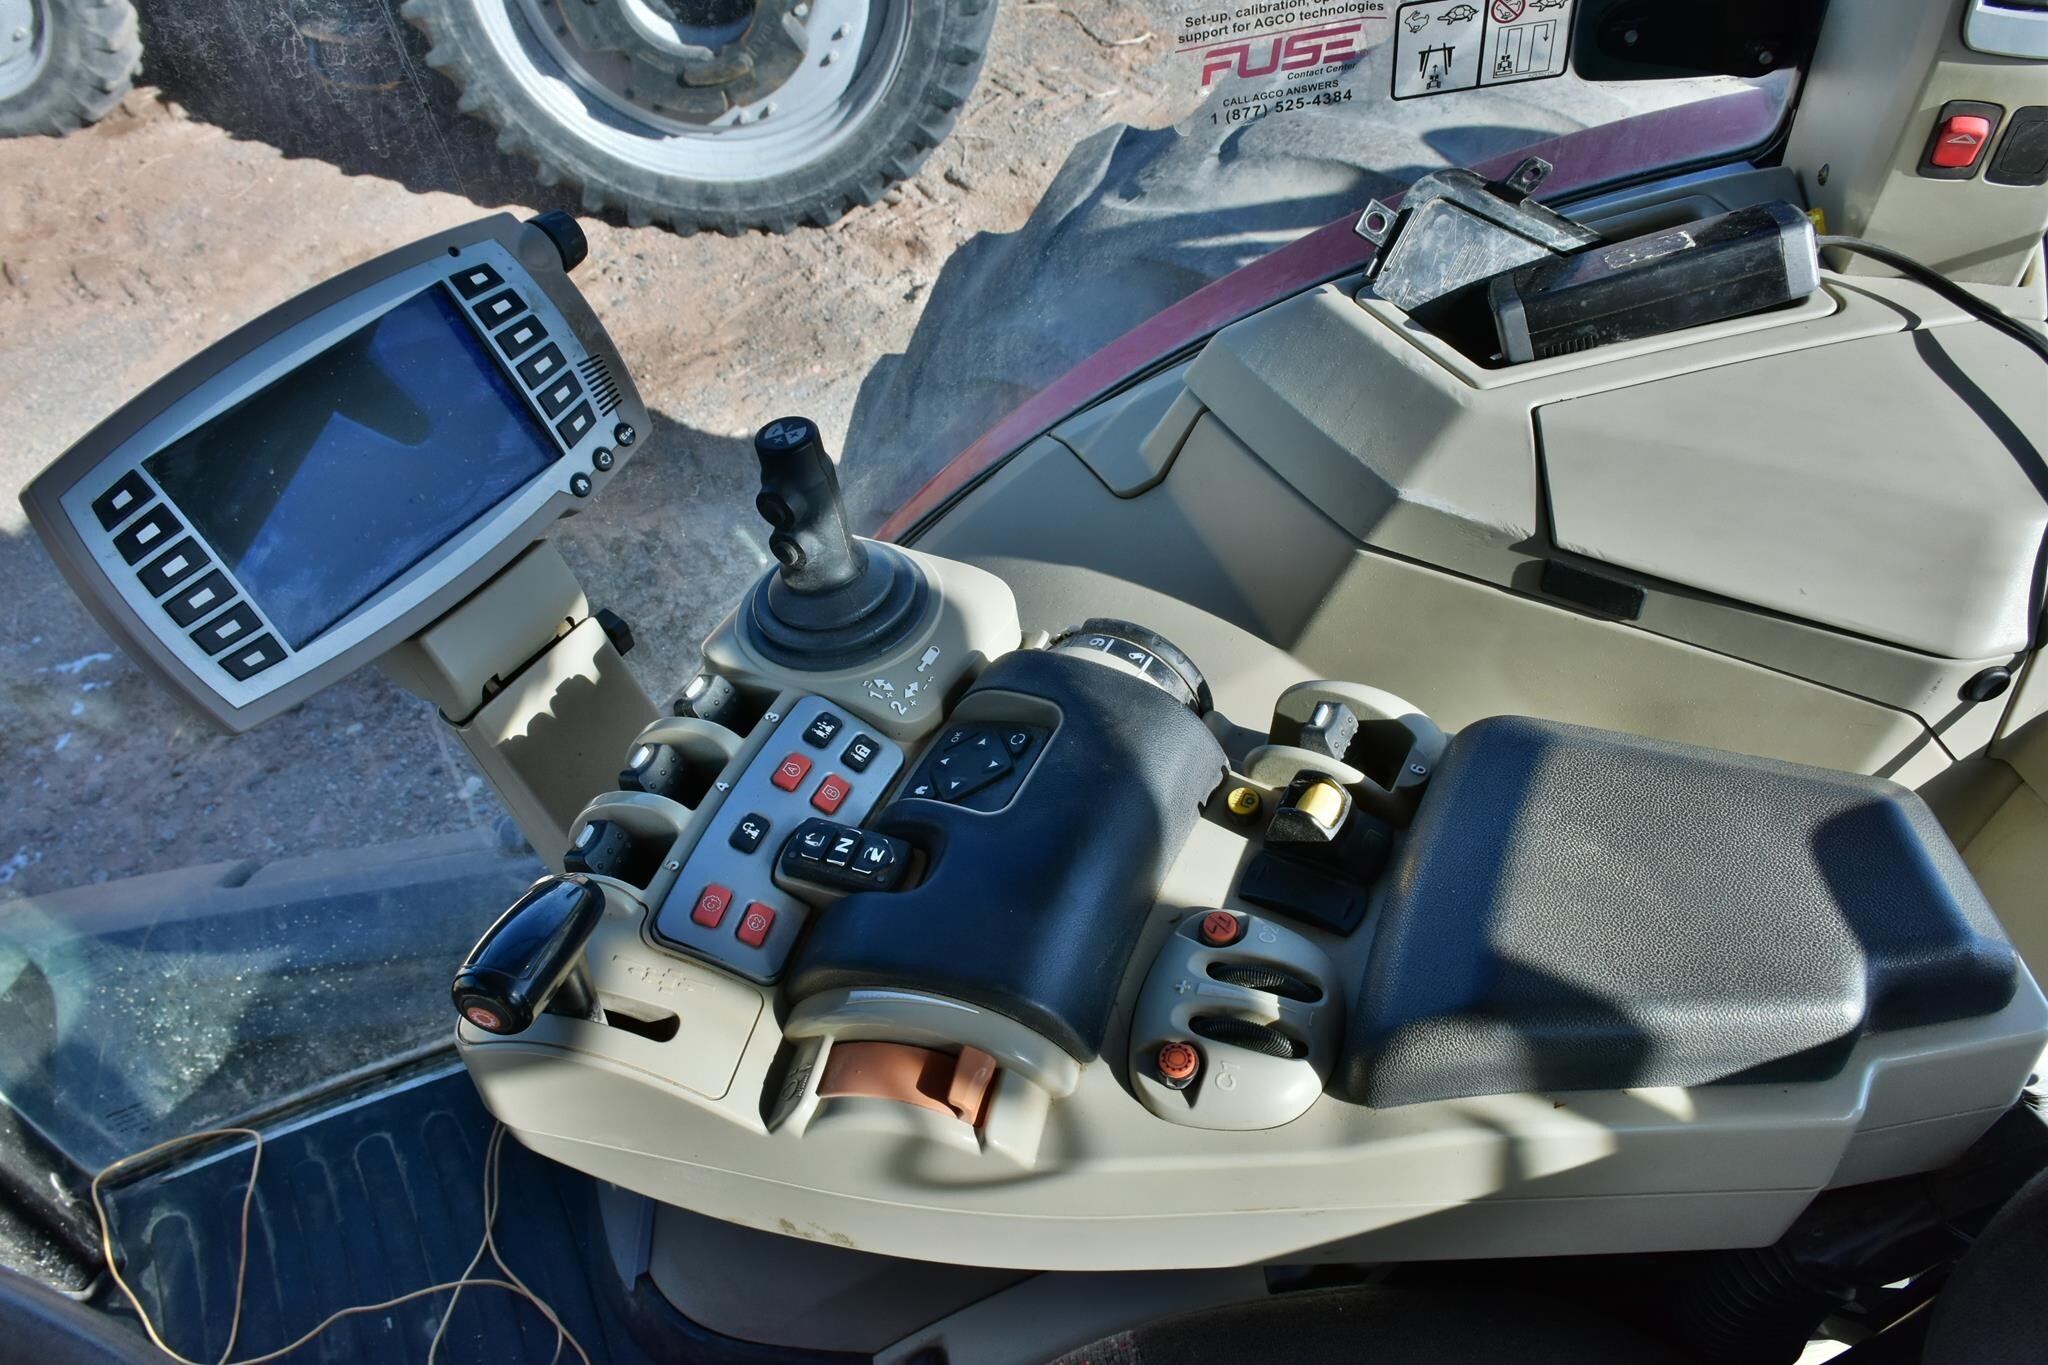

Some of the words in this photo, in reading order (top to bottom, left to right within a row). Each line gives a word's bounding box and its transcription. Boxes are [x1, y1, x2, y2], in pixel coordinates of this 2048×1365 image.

[1178, 22, 1229, 44] support
[1232, 19, 1251, 34] for
[1254, 13, 1296, 29] AGCO
[1300, 1, 1384, 21] technologies
[1184, 12, 1232, 28] Set-up,
[1201, 23, 1362, 86] FUSE
[1287, 67, 1324, 80] Contact
[1326, 62, 1357, 75] Center
[1223, 96, 1249, 107] CALL
[1252, 89, 1284, 103] AGCO
[1286, 79, 1339, 97] ANSWERS
[1210, 112, 1218, 125] 1
[1225, 103, 1268, 125] (877)
[1275, 88, 1353, 114] 525-4384
[619, 427, 633, 440] Esc
[890, 700, 908, 716] 2
[764, 711, 780, 723] 3
[716, 781, 729, 792] 4
[664, 859, 680, 872] 5
